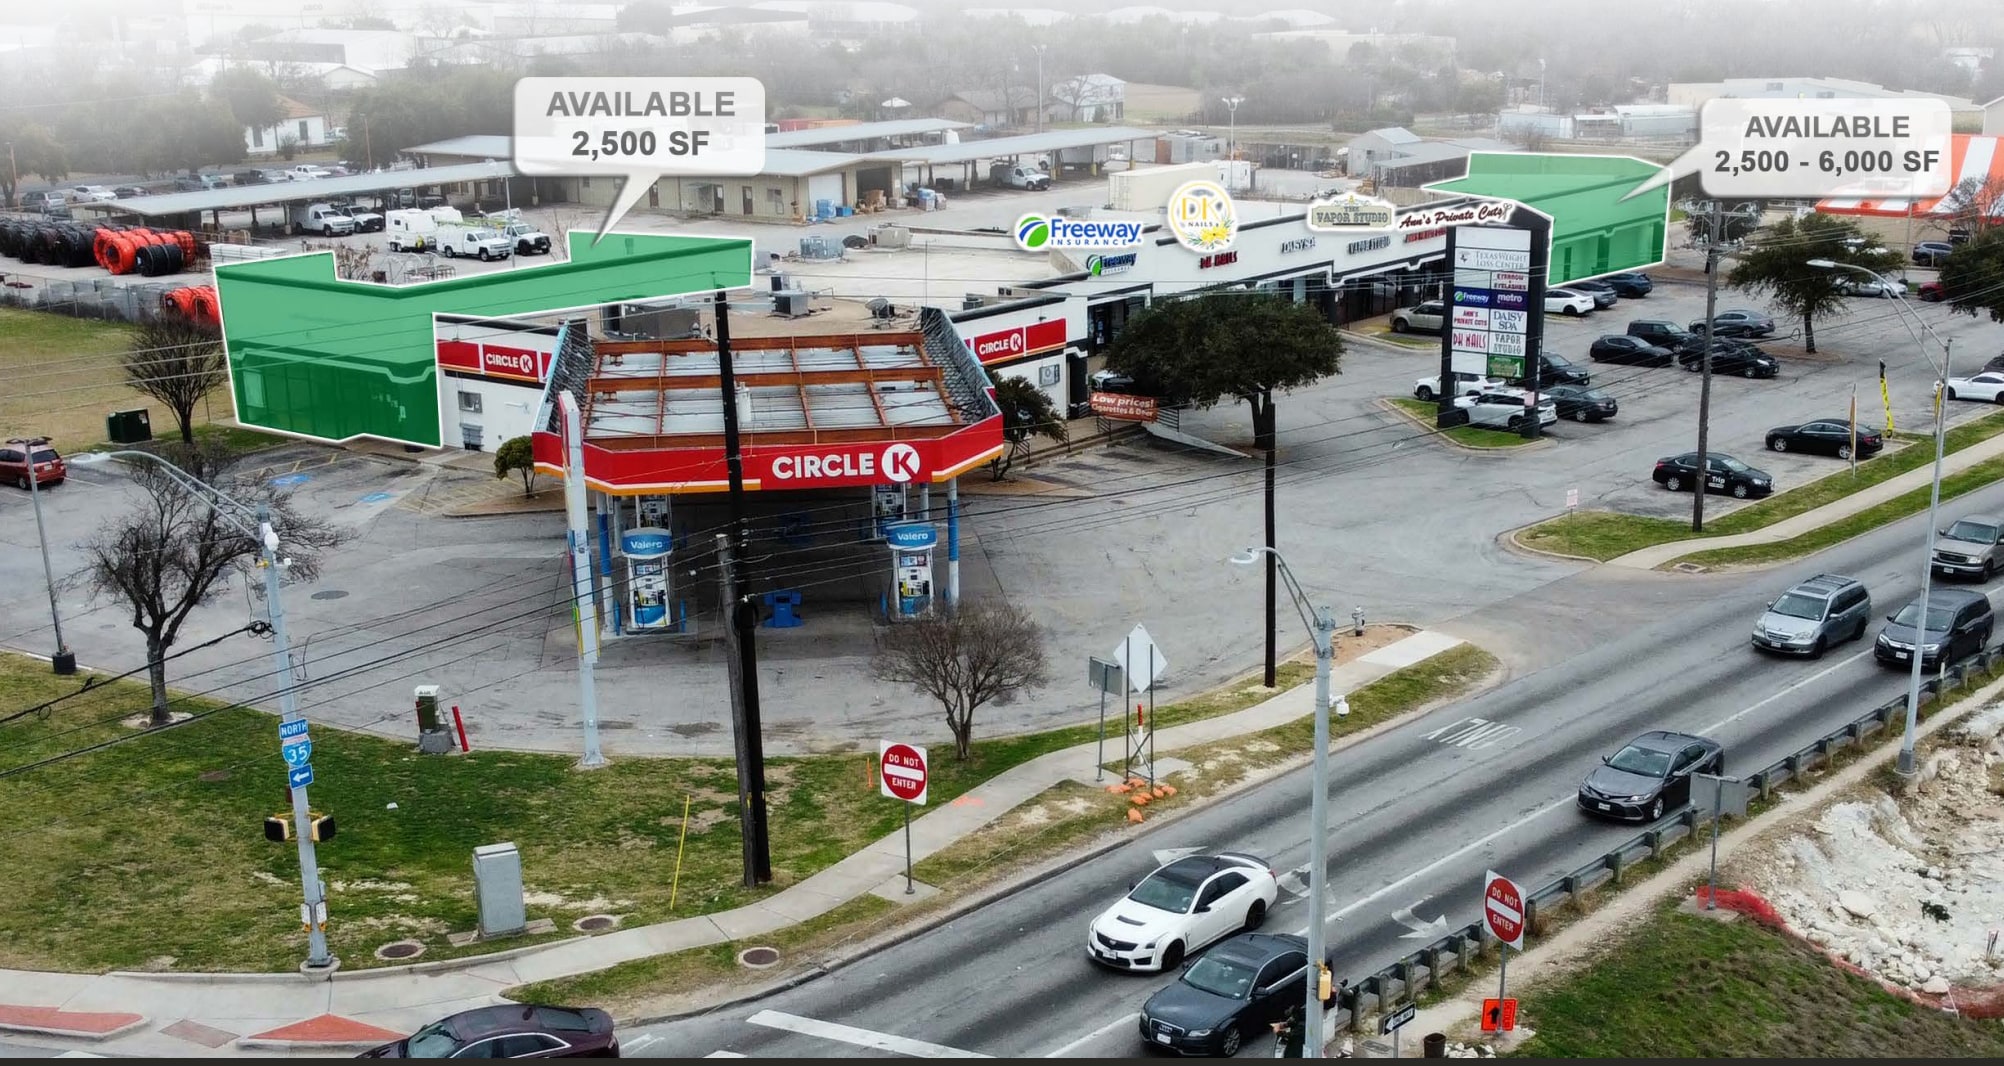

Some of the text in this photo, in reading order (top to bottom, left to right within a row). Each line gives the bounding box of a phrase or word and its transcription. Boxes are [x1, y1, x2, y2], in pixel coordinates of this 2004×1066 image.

[1475, 259, 1494, 268] LOSS
[1497, 293, 1523, 303] metro
[1493, 310, 1524, 322] DAISY
[1498, 321, 1518, 331] SPA
[978, 335, 1021, 355] CIRCLE K
[1465, 332, 1487, 349] NAILS
[1494, 333, 1521, 345] VAPOR
[1493, 343, 1522, 355] STUDIO
[485, 353, 532, 372] CIRCLE K
[1091, 402, 1128, 415] Cigarettes
[1092, 394, 1154, 409] Low prices!
[771, 448, 919, 481] CIRCLE K
[280, 721, 307, 737] NORTH
[1418, 716, 1522, 750] ONLY
[288, 745, 308, 763] 35
[889, 753, 919, 768] DO NOT
[892, 777, 916, 790] ENTER
[1491, 886, 1518, 908] DO NOT
[1492, 913, 1514, 933] ENTER
